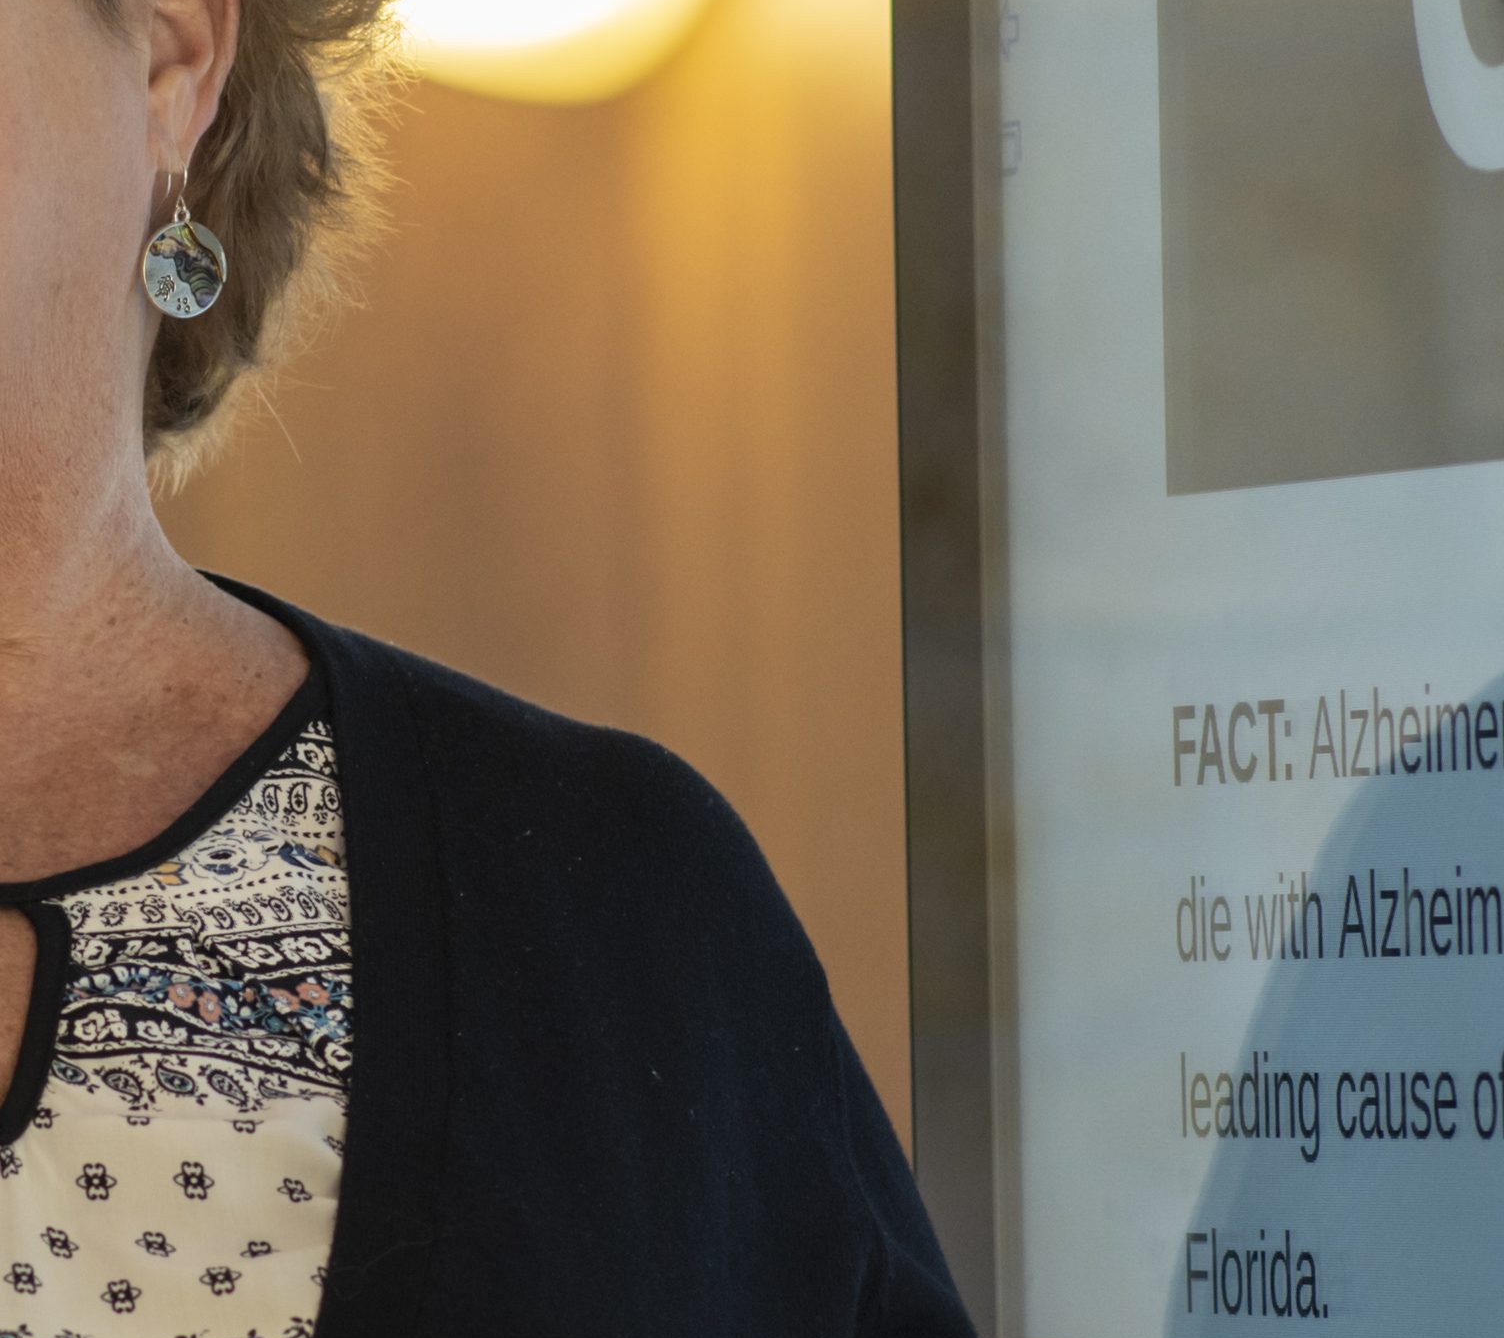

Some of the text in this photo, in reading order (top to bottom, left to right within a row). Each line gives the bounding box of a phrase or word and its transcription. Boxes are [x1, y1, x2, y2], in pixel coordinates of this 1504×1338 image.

[1172, 699, 1292, 787] FACT:
[1176, 875, 1232, 962] die
[1245, 871, 1325, 961] with
[1180, 1051, 1322, 1163] leading
[1335, 1069, 1458, 1140] cause
[1185, 1227, 1330, 1320] Florida.
